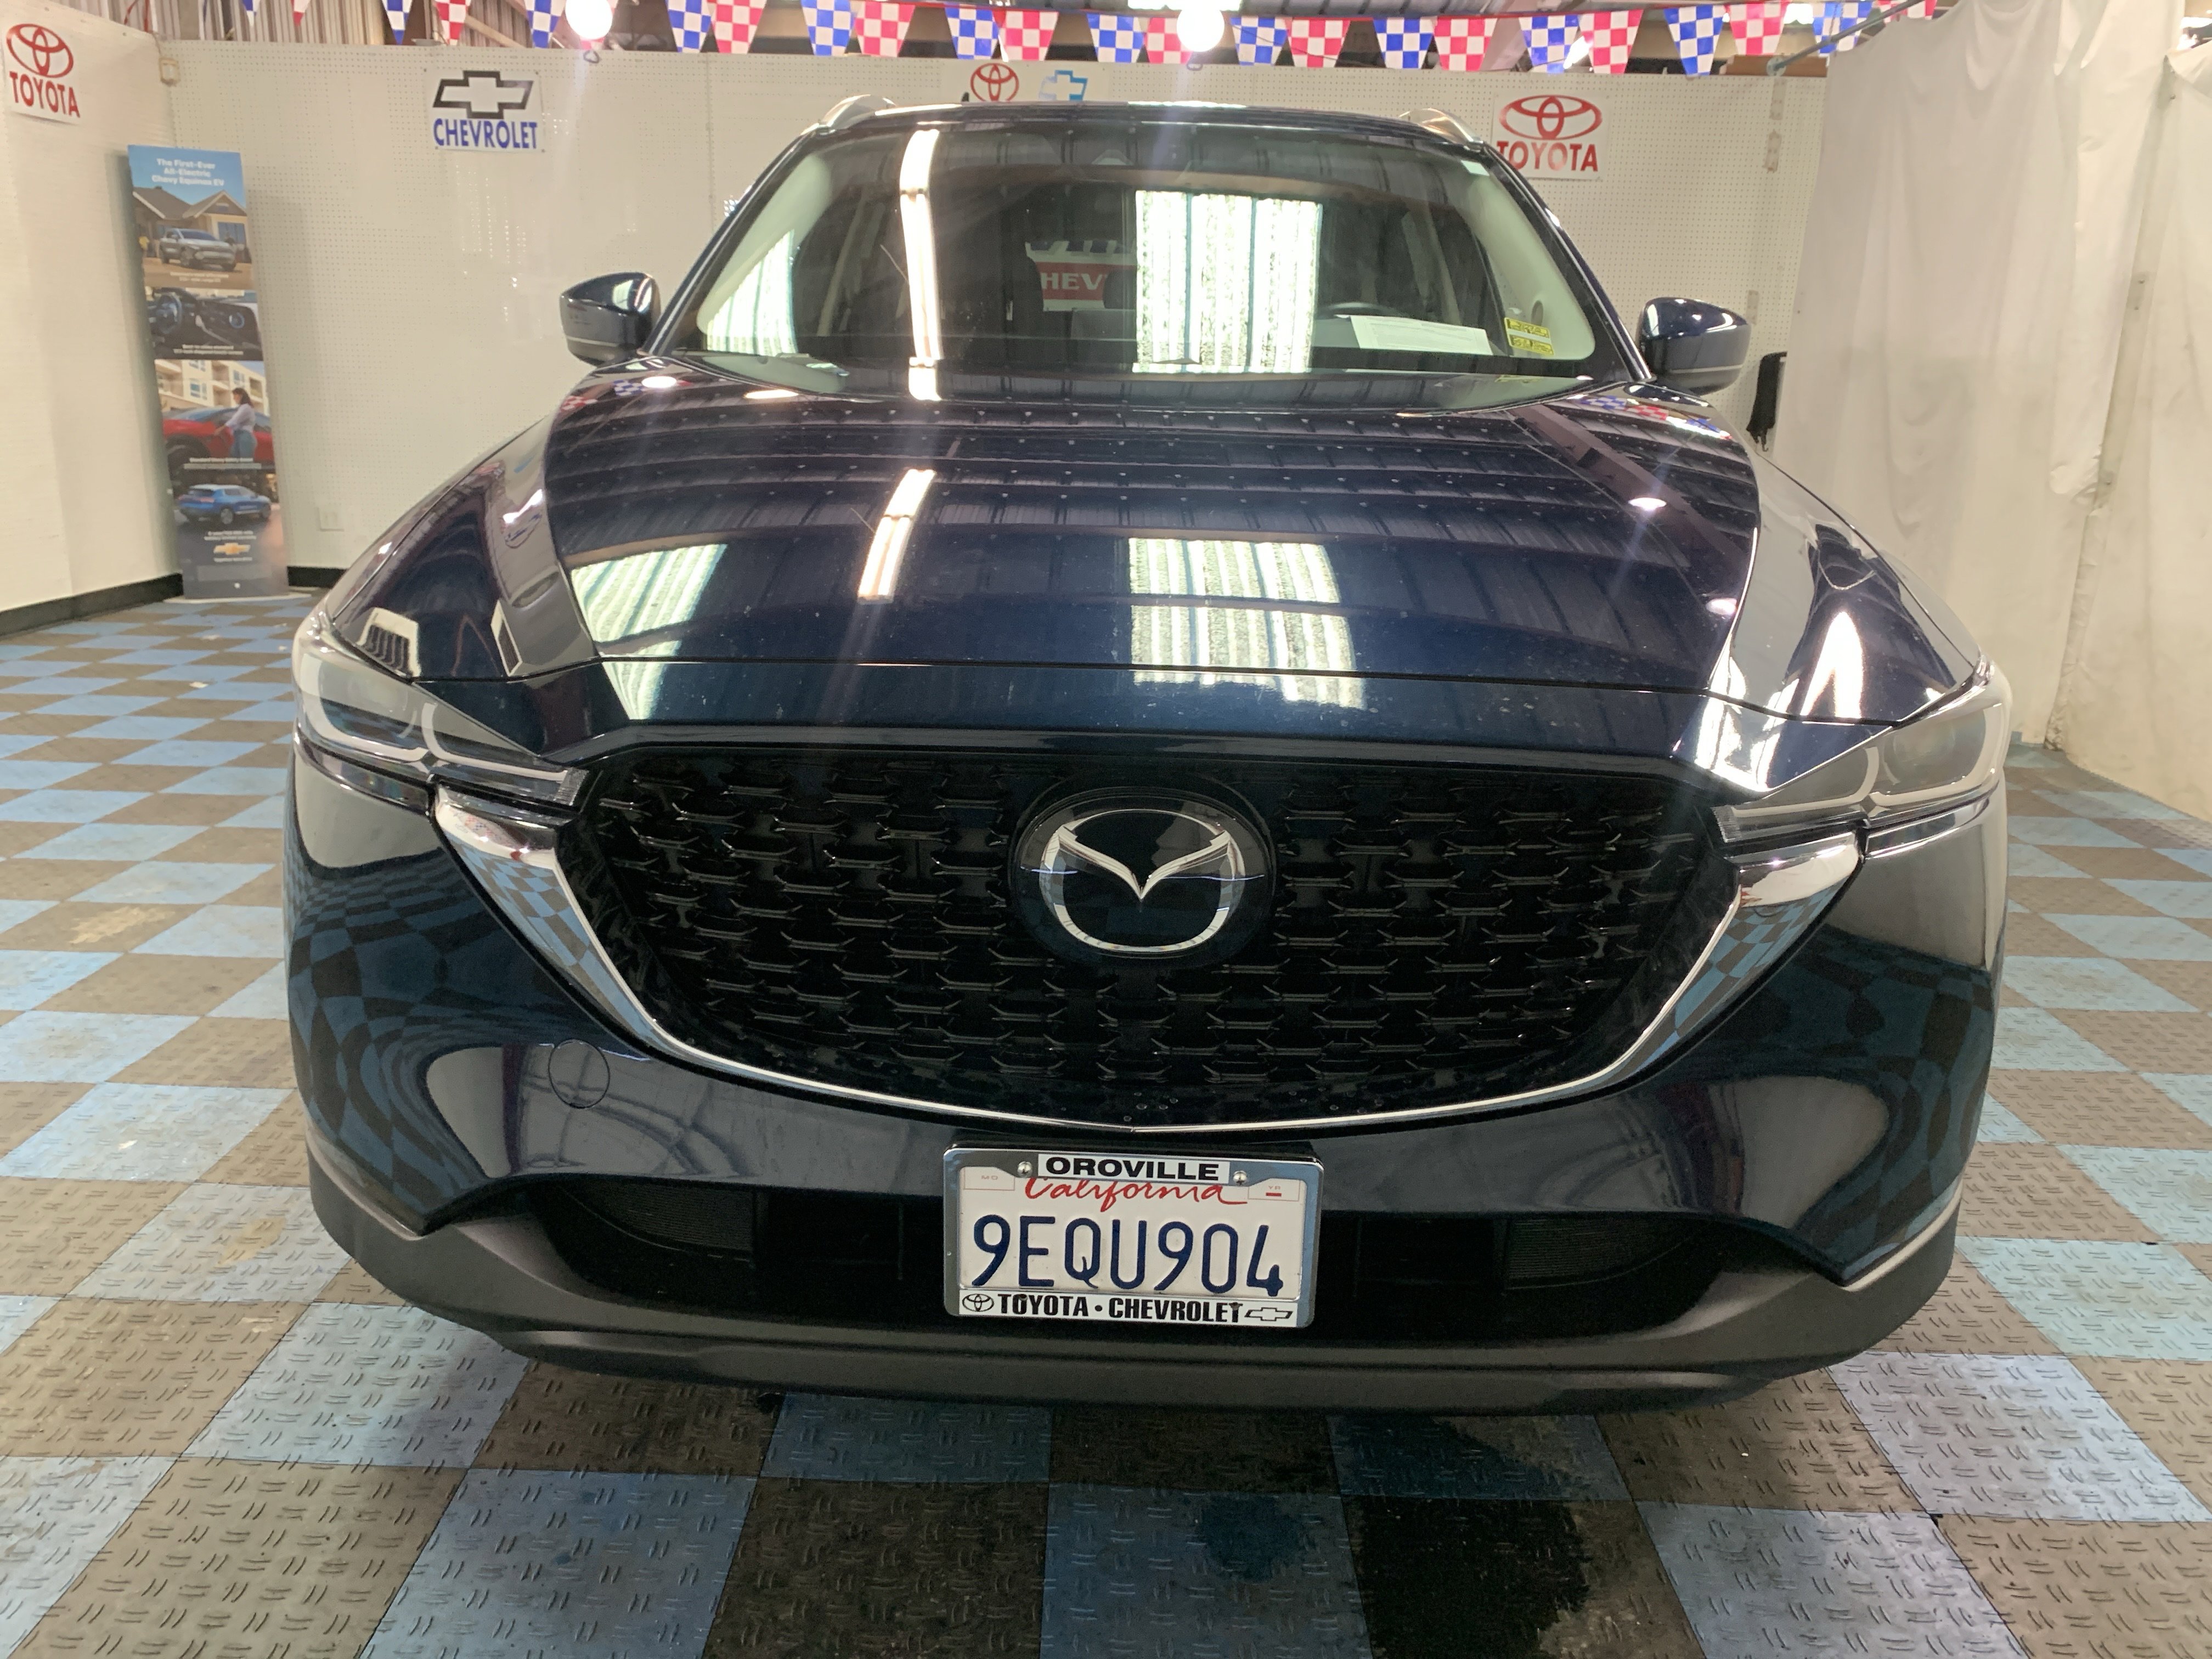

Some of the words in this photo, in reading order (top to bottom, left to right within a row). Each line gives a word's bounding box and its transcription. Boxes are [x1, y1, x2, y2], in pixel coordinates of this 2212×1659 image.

[9, 71, 80, 118] TOYOTA
[433, 118, 537, 149] CHEVROLET
[156, 158, 172, 166] The
[174, 159, 216, 170] First-Ever
[1497, 140, 1598, 172] TOYOTA
[151, 174, 177, 185] Chevy
[213, 178, 224, 187] EV
[1046, 1156, 1220, 1181] OROVILLE
[1025, 1176, 1248, 1212] California
[972, 1214, 1283, 1297] 9EQU904
[997, 1294, 1089, 1316] TOYOTA
[1108, 1297, 1244, 1323] CHEVROLET
